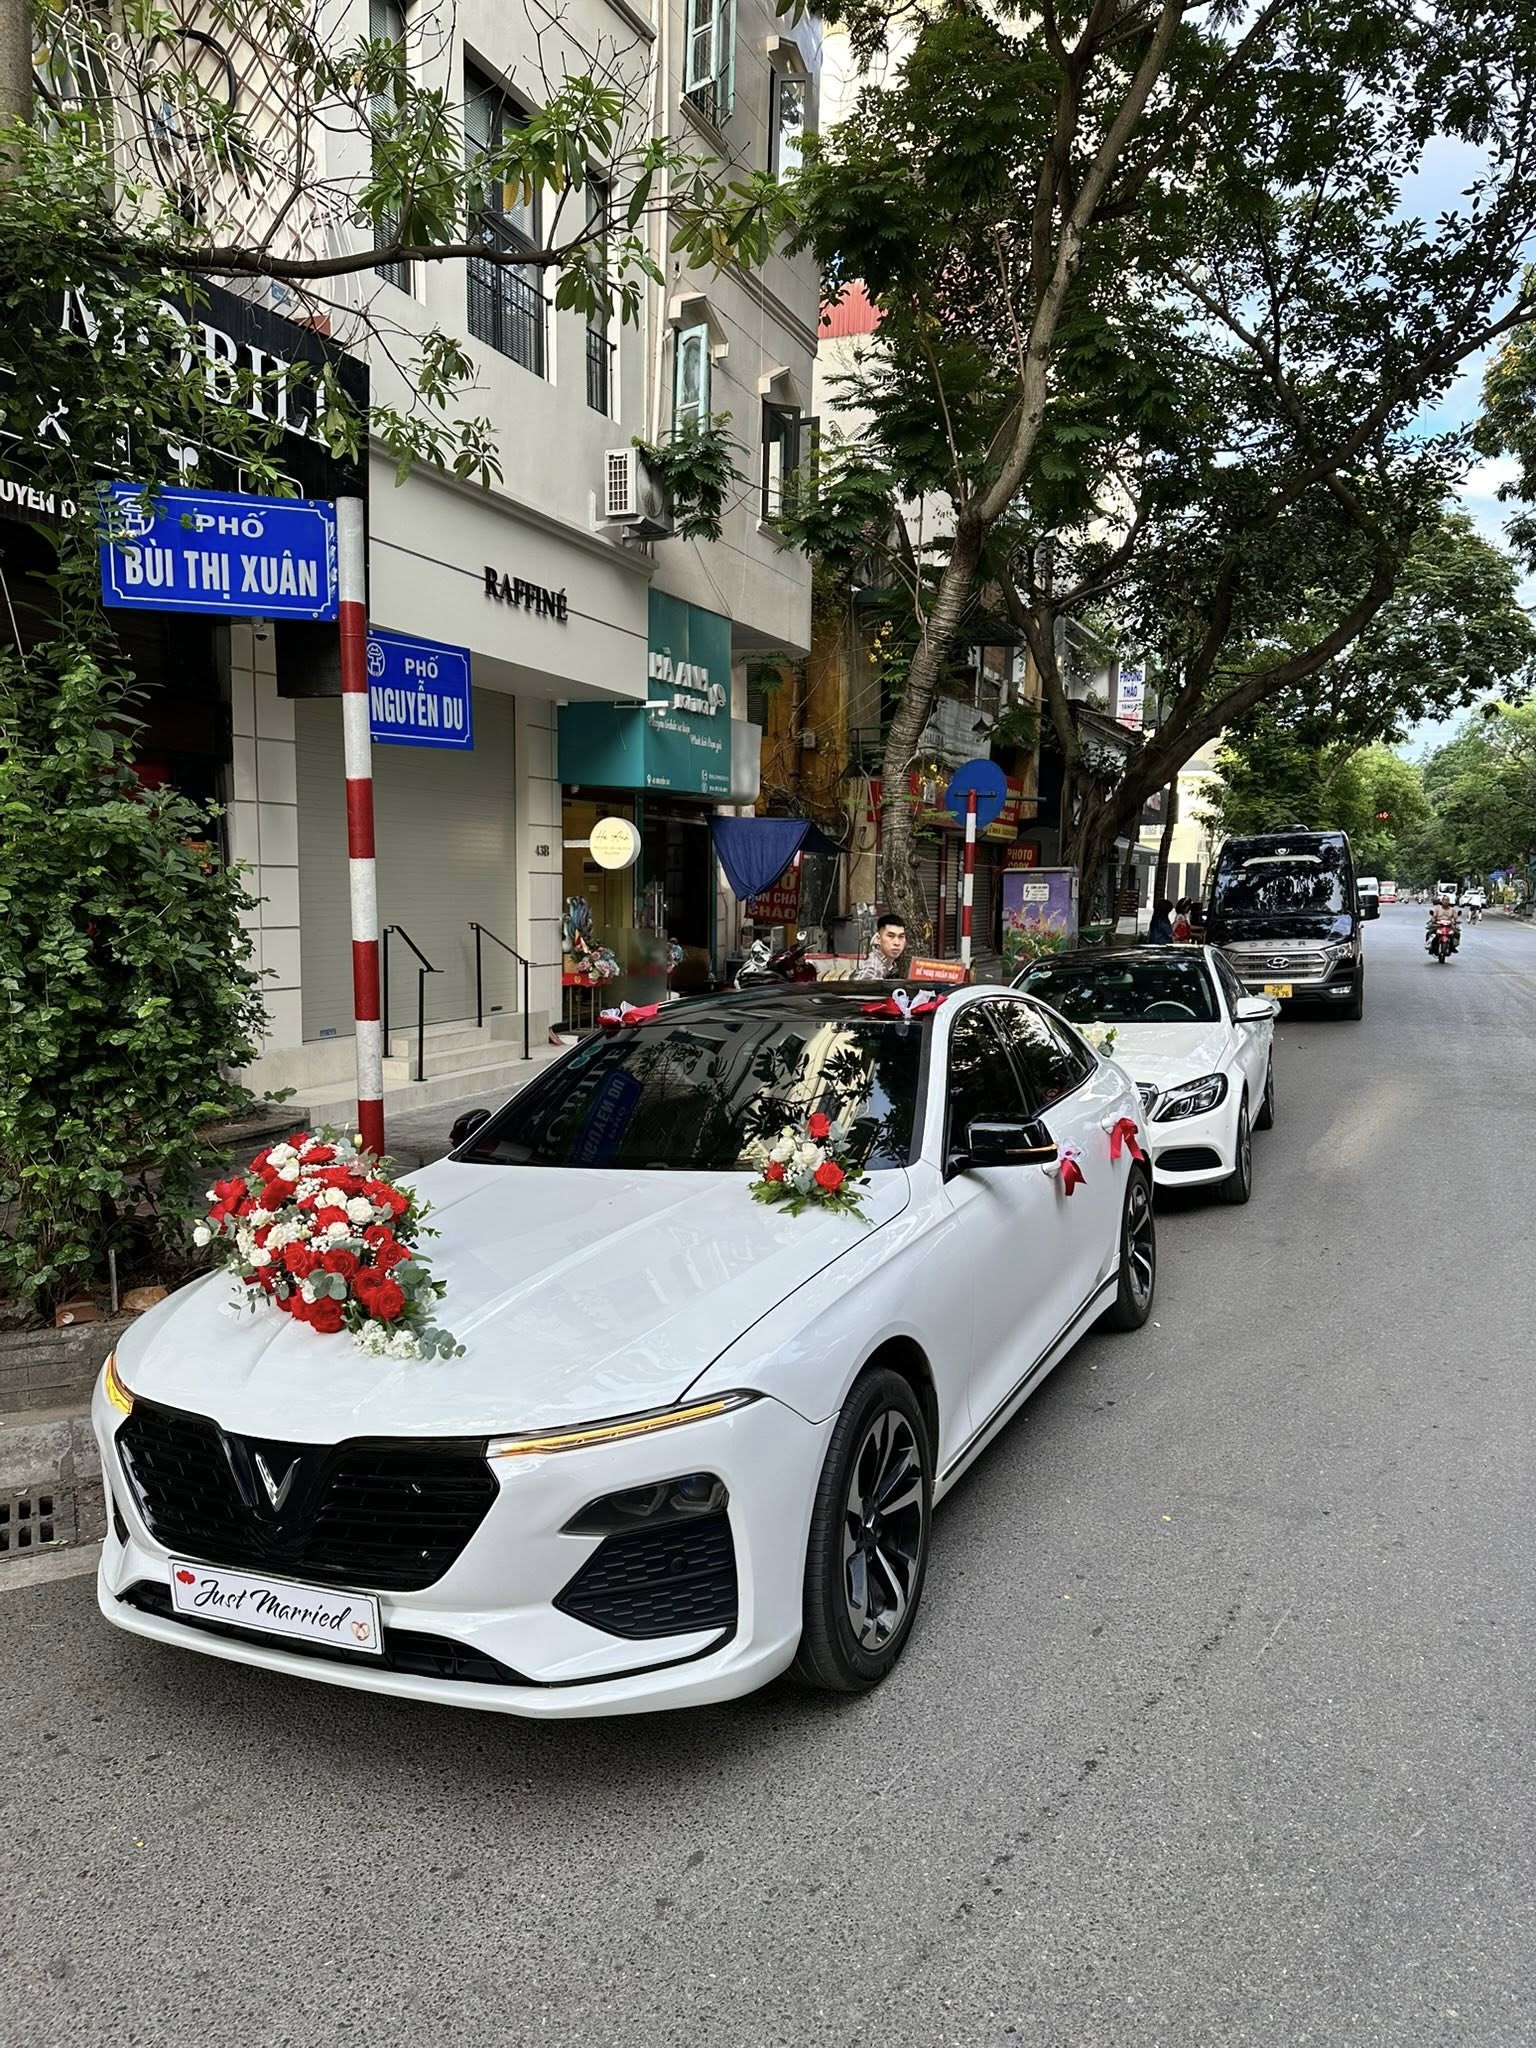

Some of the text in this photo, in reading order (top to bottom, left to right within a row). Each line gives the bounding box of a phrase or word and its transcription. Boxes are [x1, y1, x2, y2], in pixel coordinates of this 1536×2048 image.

[195, 511, 267, 538] PHỐ
[125, 538, 318, 600] BÙI THỊ XUÂN
[484, 565, 568, 621] RAFFINÉ
[404, 655, 439, 679] PHỐ
[370, 679, 463, 731] NGUYỄN DU
[535, 845, 550, 857] 43B
[1007, 848, 1033, 861] PHOTO
[194, 1579, 352, 1631] Just Married
